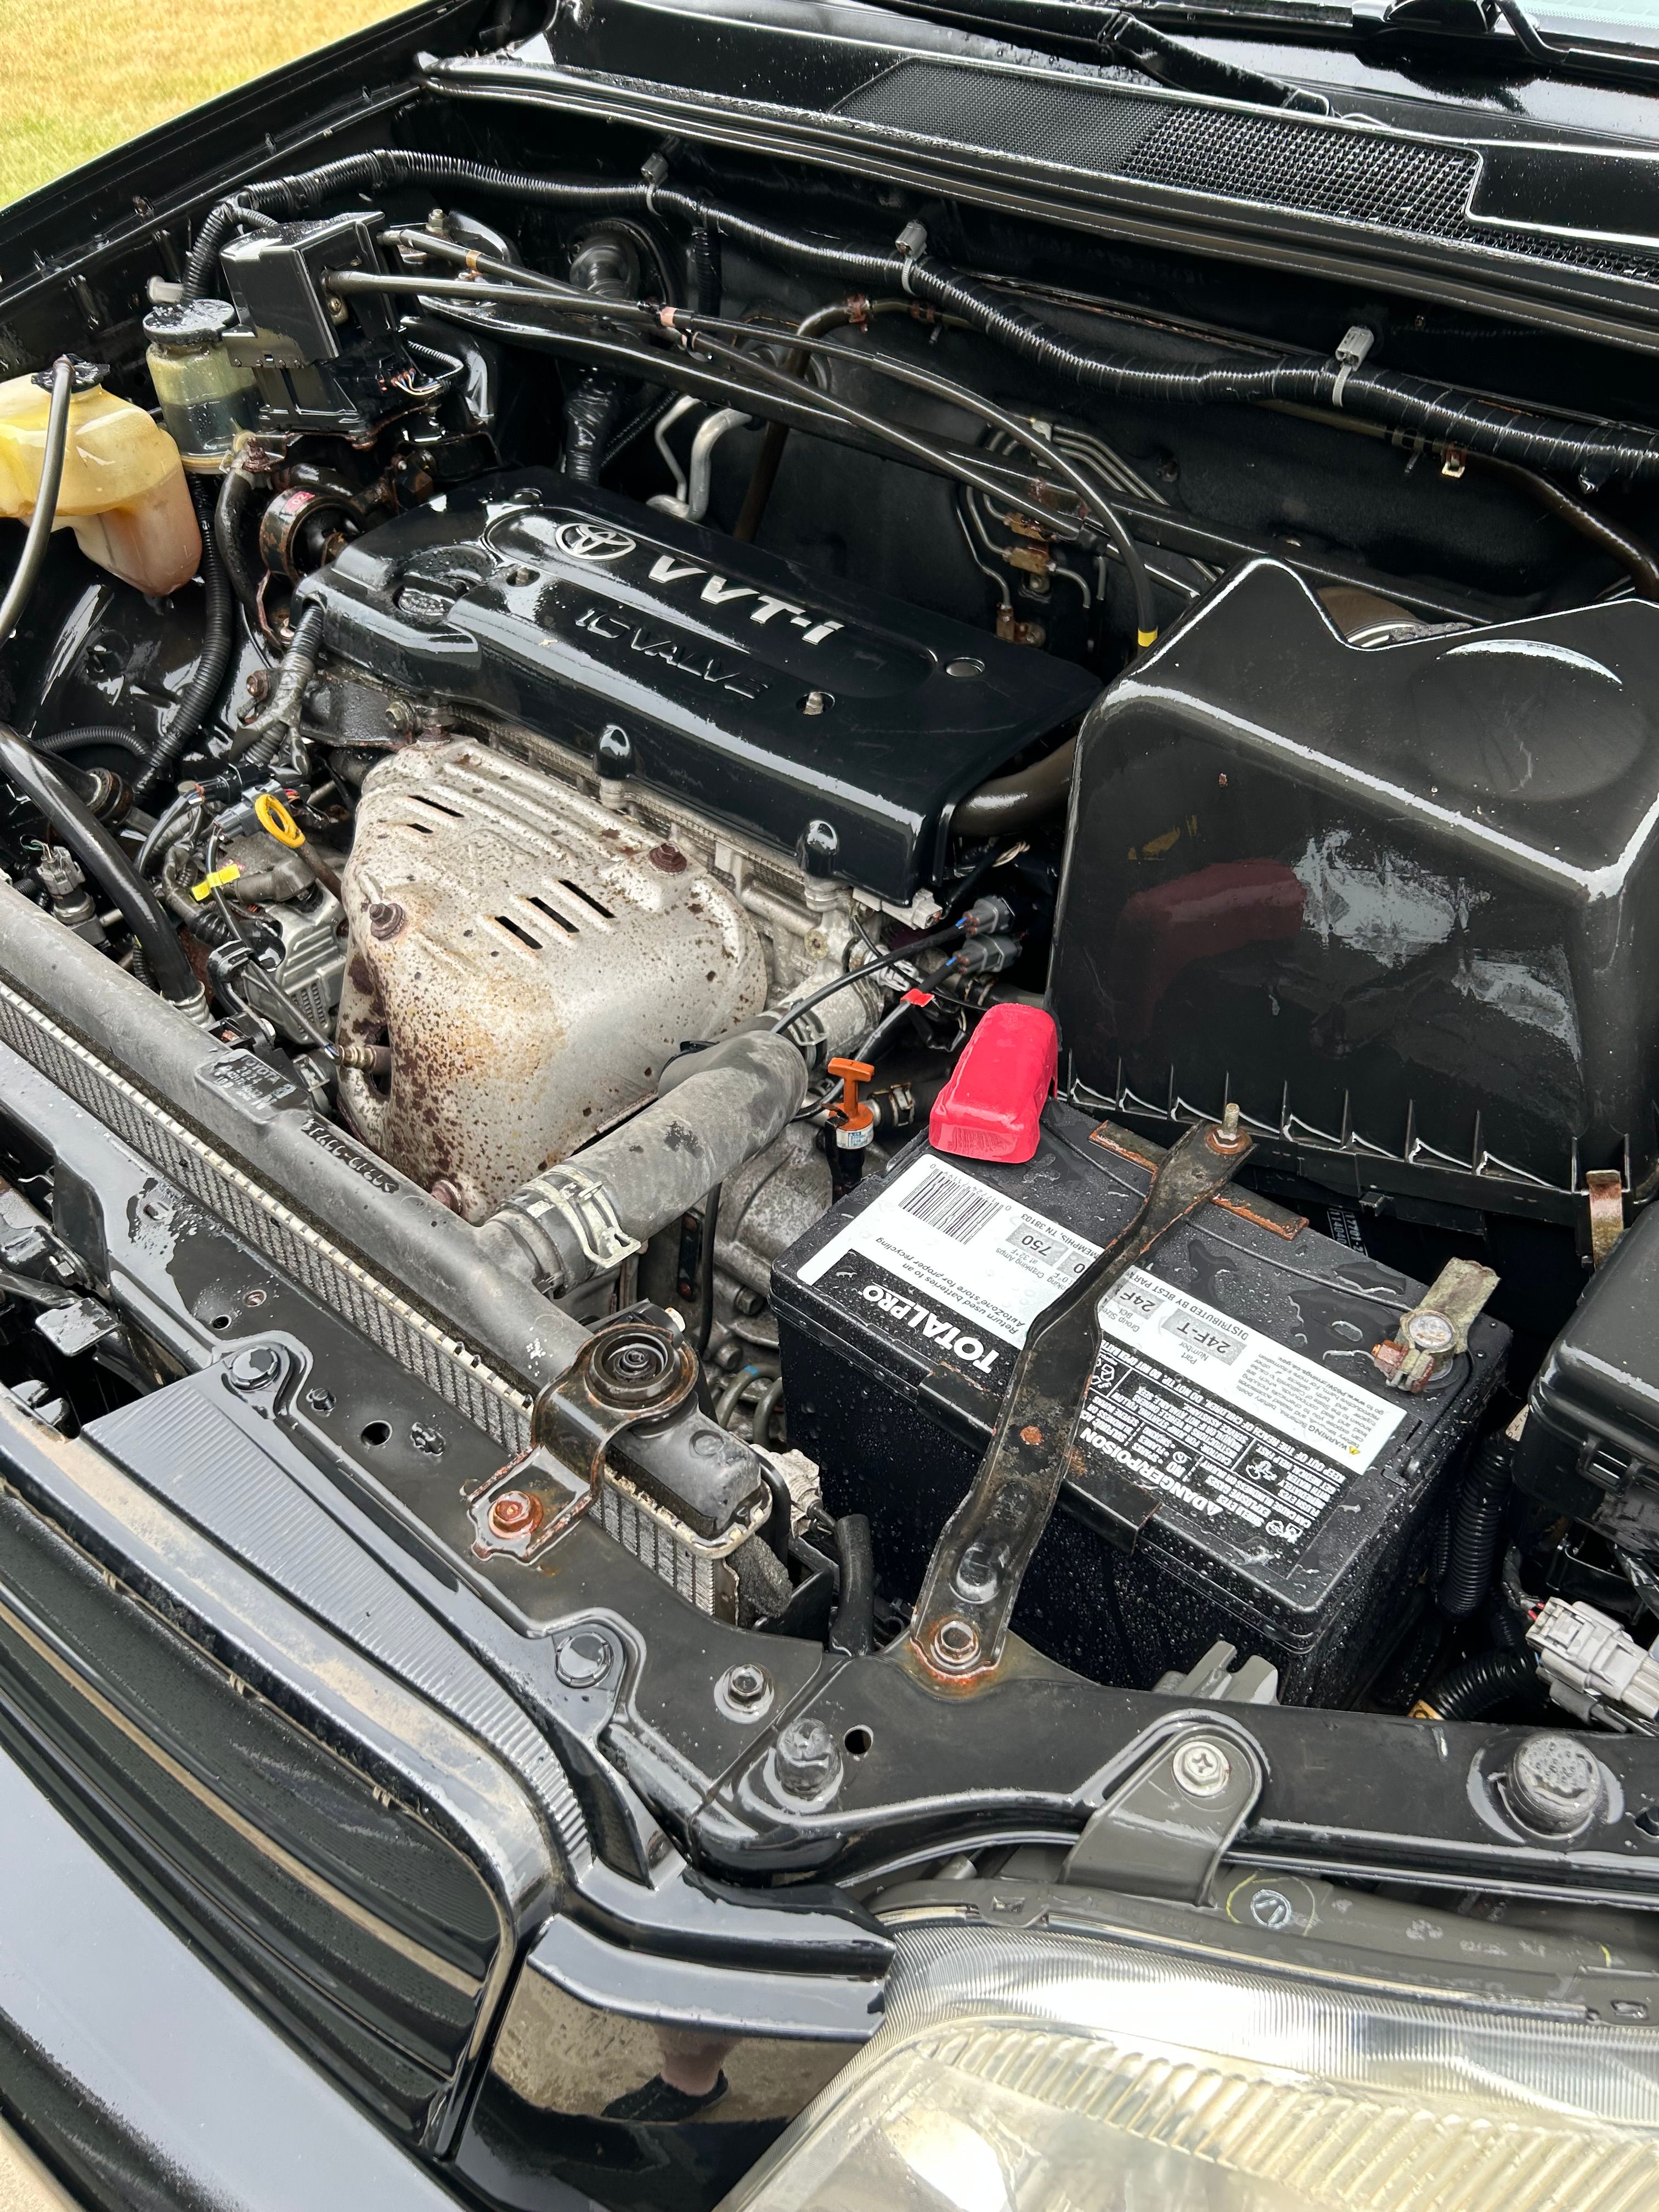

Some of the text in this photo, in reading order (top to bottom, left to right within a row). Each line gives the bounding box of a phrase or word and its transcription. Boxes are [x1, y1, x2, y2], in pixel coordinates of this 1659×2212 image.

[648, 554, 844, 645] VVT-i
[631, 628, 768, 699] VALVE
[241, 1056, 281, 1084] TOYOTA
[1019, 1212, 1101, 1259] MEMPHIS, TN 38103
[1019, 1233, 1053, 1257] 750
[874, 1236, 915, 1262] recycling
[912, 1258, 944, 1279] proper
[994, 1246, 1047, 1279] Cranking Amps
[1028, 1257, 1039, 1265] at
[940, 1276, 956, 1288] for
[901, 1262, 1019, 1335] Return used batteries to an
[955, 1285, 980, 1301] store
[1119, 1288, 1156, 1313] 24F
[1151, 1284, 1176, 1301] BEST
[1175, 1297, 1189, 1308] BY
[1116, 1316, 1141, 1332] Group
[1189, 1304, 1250, 1340] DISTRIBUTED
[1176, 1319, 1231, 1355] 24F-T
[1118, 1350, 1139, 1365] OPEN
[1177, 1341, 1209, 1361] Number
[1180, 1352, 1197, 1364] Part
[1135, 1360, 1152, 1373] NOT
[1148, 1367, 1163, 1379] DO
[1160, 1374, 1177, 1387] TIP.
[1174, 1383, 1192, 1396] NOT
[1110, 1391, 1139, 1410] FOLLOW
[1135, 1386, 1155, 1400] SEEK
[1188, 1391, 1204, 1403] DO
[1086, 1403, 1134, 1435] BLINDNESS OR
[1091, 1395, 1140, 1427] SEVERE BURNS
[1157, 1408, 1185, 1427] VEHICLE
[1184, 1414, 1201, 1426] NOT
[1202, 1398, 1244, 1425] CHILDREN.
[1091, 1417, 1128, 1443] SULFURIC
[1166, 1424, 1187, 1439] JUMP
[1182, 1423, 1193, 1432] IN
[1197, 1421, 1207, 1431] IF
[1204, 1425, 1217, 1436] OR
[1219, 1423, 1249, 1444] SERVICE
[1240, 1420, 1256, 1432] OF
[1183, 1434, 1201, 1447] FOR
[1214, 1431, 1244, 1452] MANUAL
[1251, 1426, 1281, 1447] REACH
[1307, 1424, 1348, 1450] WARNING
[1277, 1440, 1296, 1455] THE
[1294, 1451, 1309, 1463] OF
[1077, 1426, 1210, 1511] DANGER/POISON
[1164, 1460, 1187, 1478] NO
[1253, 1443, 1337, 1495] GET MEDICAL HELP FAST.
[1305, 1456, 1326, 1472] OUT
[1223, 1473, 1238, 1485] OR
[1322, 1466, 1347, 1484] KEEP
[1204, 1474, 1272, 1518] EXPLOSIVE GASES
[1283, 1471, 1331, 1502] WITH WATER.
[1215, 1493, 1265, 1527] SHIELD EYES
[1271, 1500, 1297, 1520] CAUSE
[1276, 1488, 1321, 1517] FLUSH EYES
[1293, 1514, 1313, 1529] CAN
